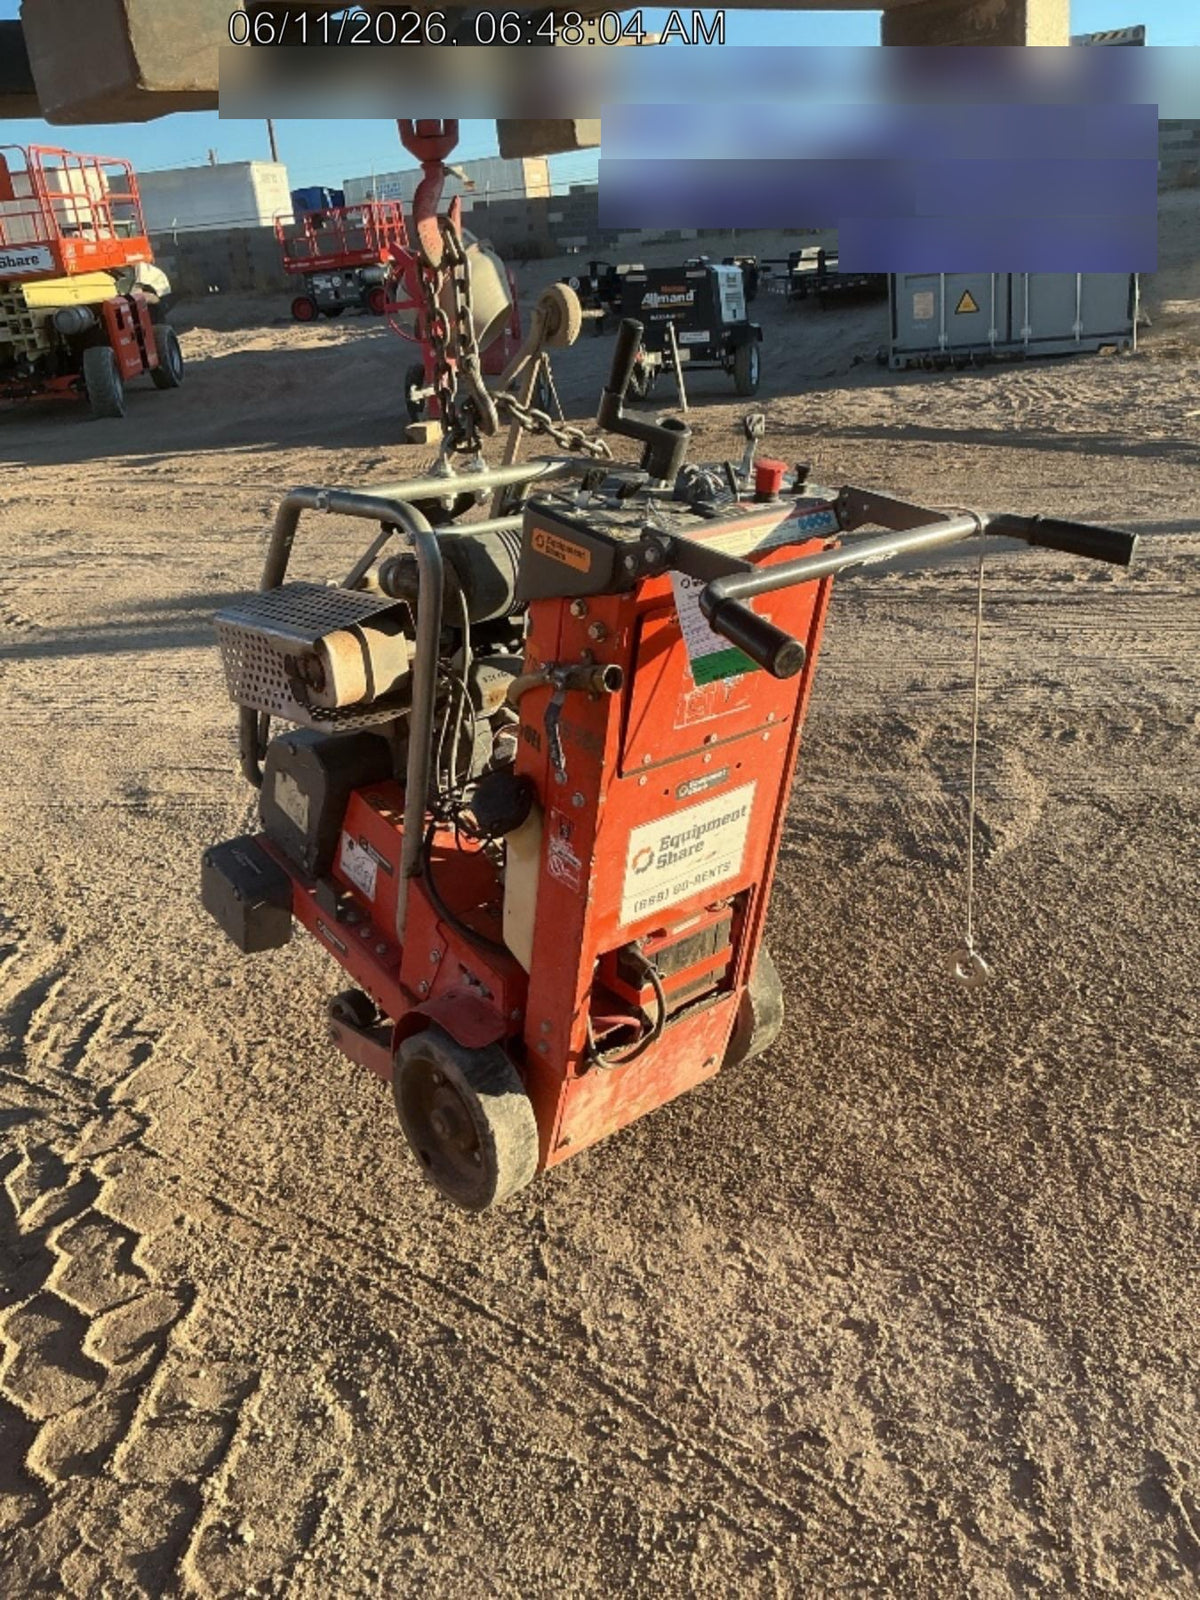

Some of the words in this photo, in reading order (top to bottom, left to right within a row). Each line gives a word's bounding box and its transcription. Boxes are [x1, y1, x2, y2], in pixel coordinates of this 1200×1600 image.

[641, 290, 695, 308] Allmand
[659, 805, 747, 852] Equipment
[656, 841, 705, 869] Share
